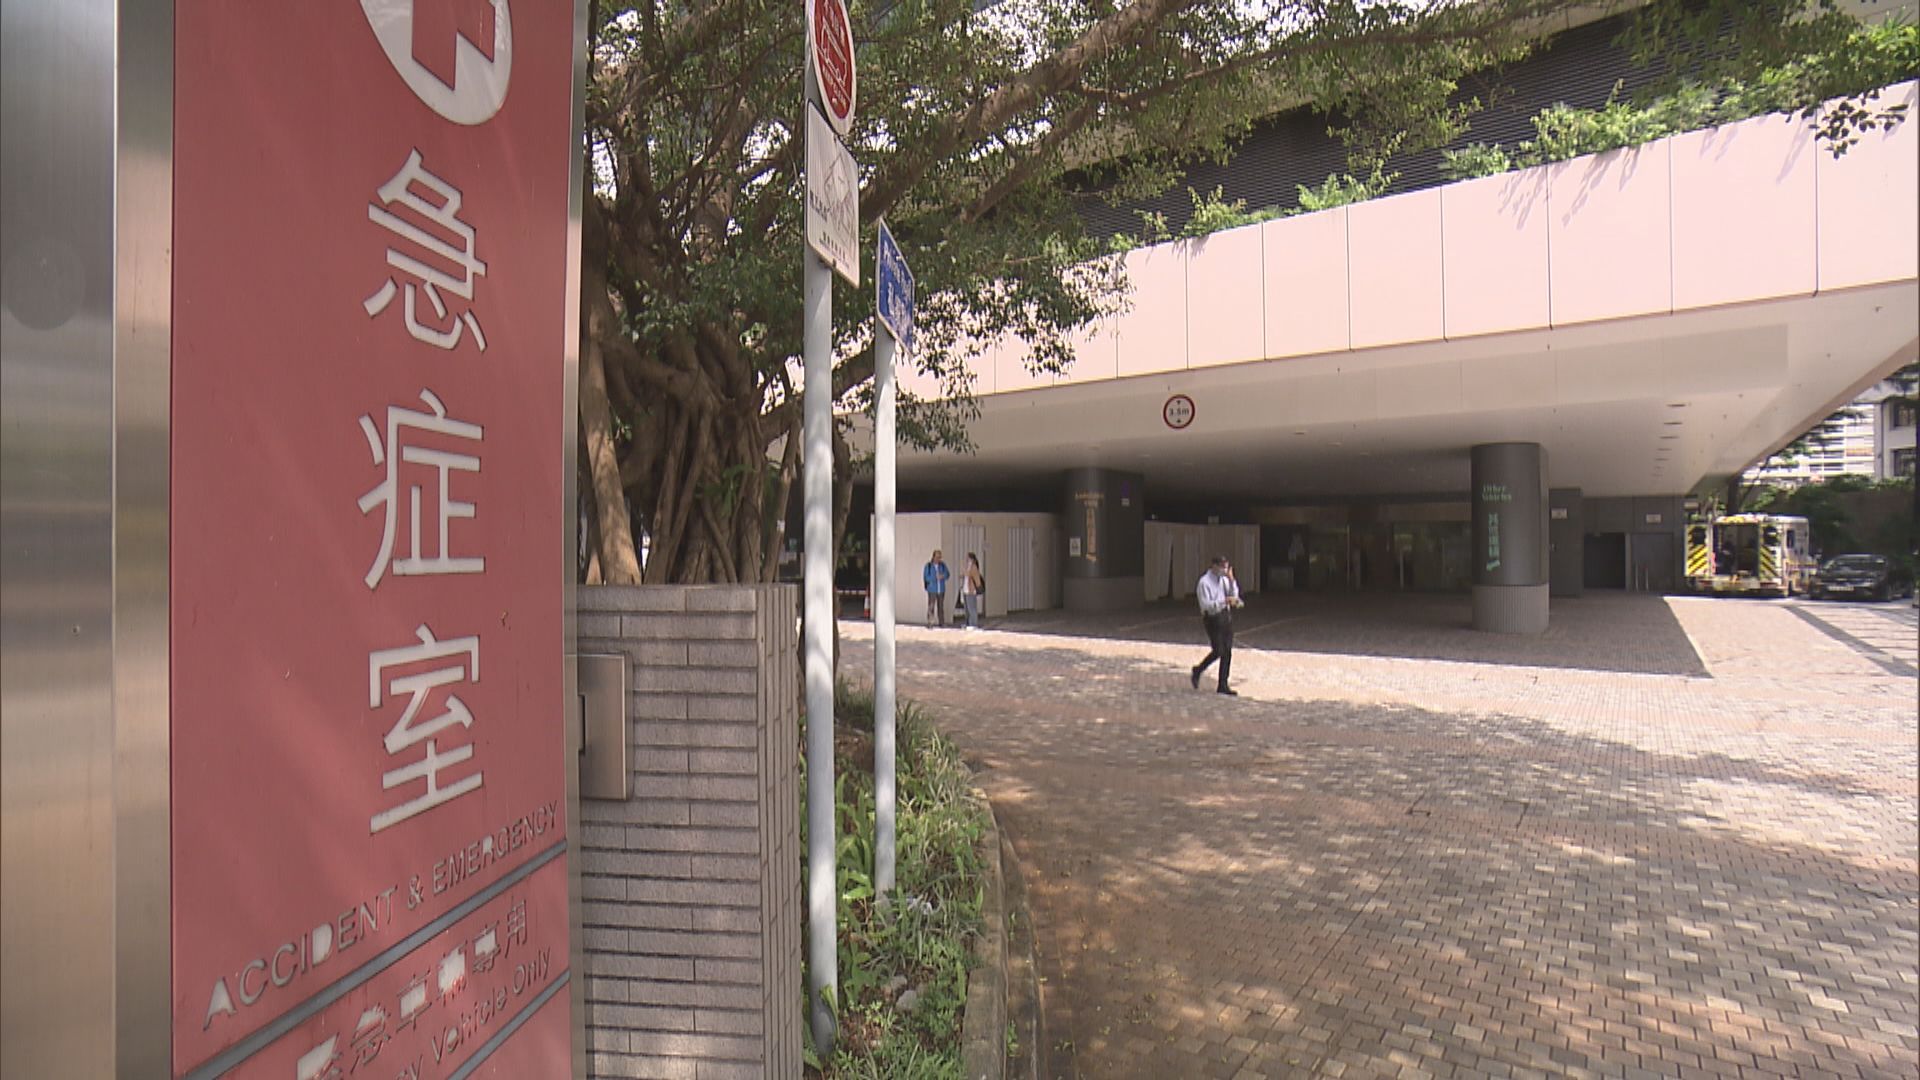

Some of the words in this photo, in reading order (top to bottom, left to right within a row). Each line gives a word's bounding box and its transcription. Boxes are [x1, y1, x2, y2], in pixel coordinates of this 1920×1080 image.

[357, 146, 489, 834] 急症室
[203, 885, 398, 1032] ACCIDENT
[407, 875, 424, 911] &
[432, 800, 560, 895] EMERGENCY
[432, 986, 508, 1063] Vehicle
[512, 946, 551, 995] Only
